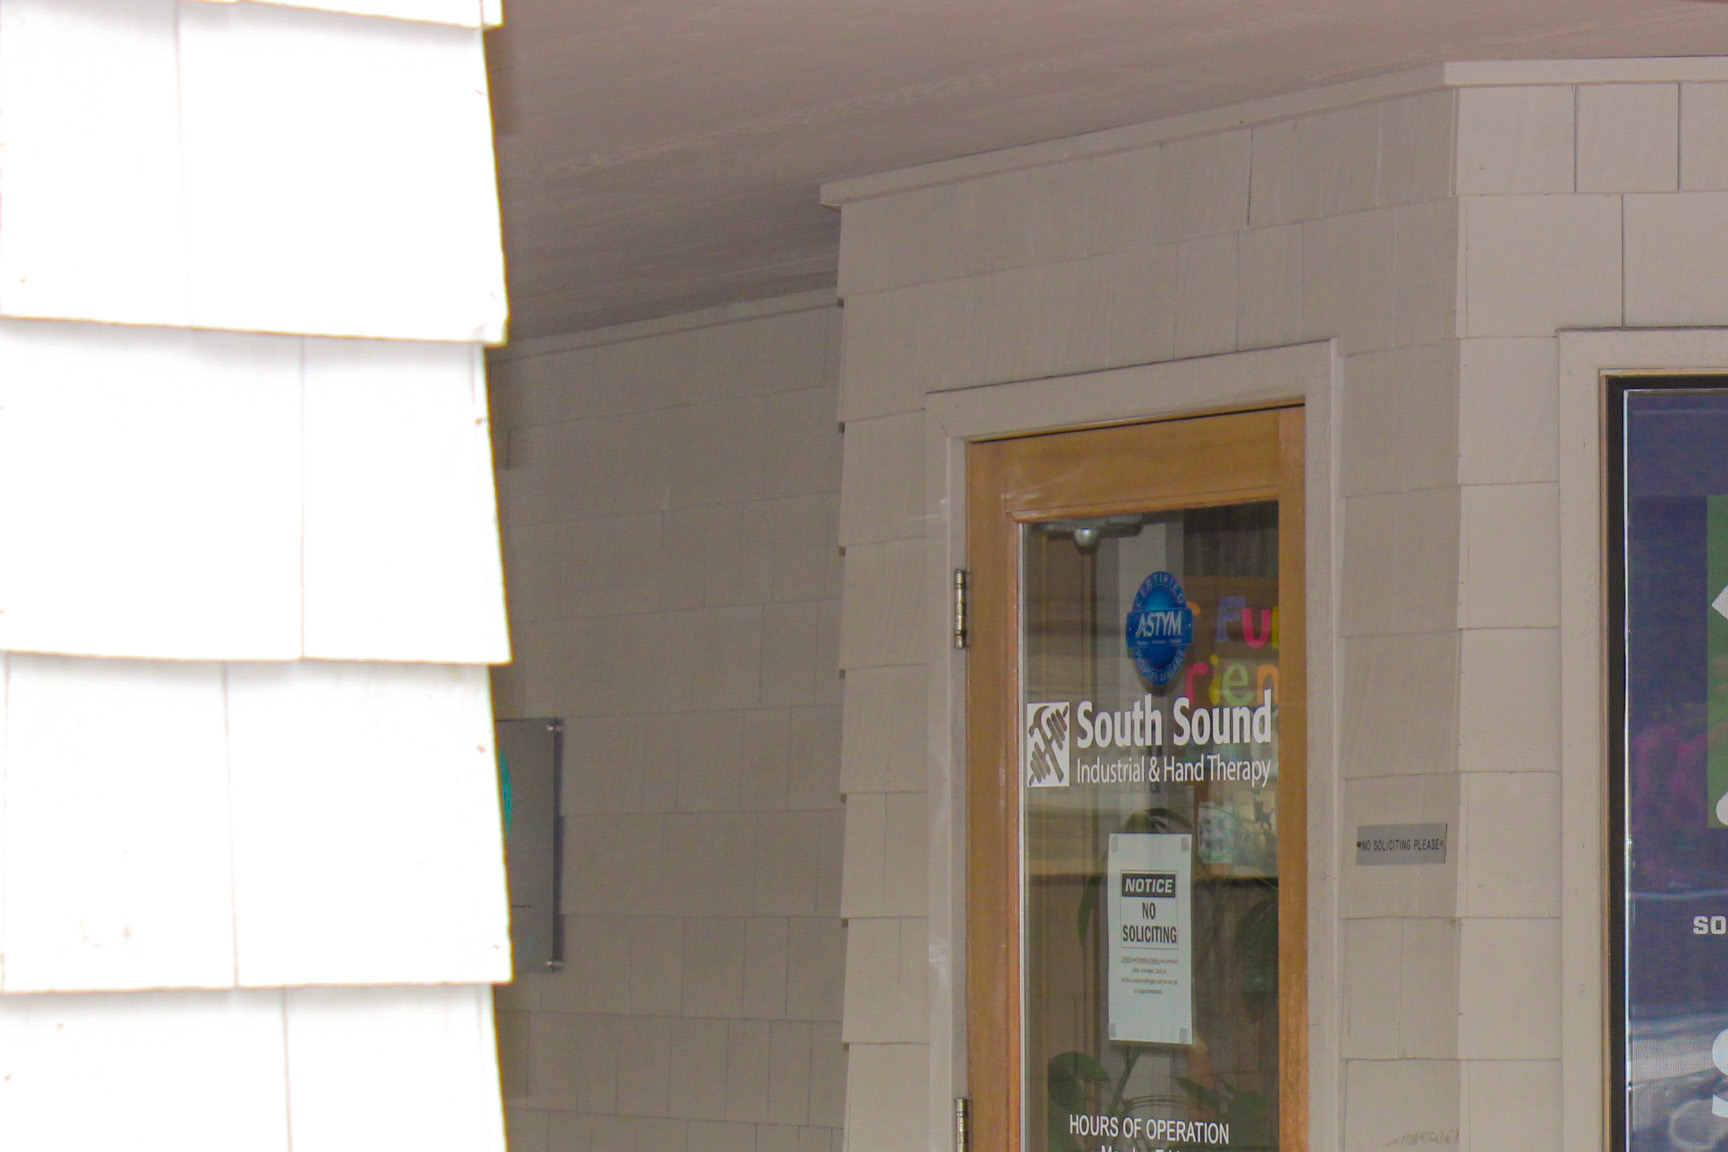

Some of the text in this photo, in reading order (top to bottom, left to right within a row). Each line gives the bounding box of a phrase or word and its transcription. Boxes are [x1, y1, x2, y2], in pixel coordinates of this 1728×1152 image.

[1135, 611, 1182, 638] ASTYM
[1077, 688, 1272, 749] South Sound
[1077, 753, 1271, 788] Industrial & Hand Therapy
[1362, 838, 1440, 852] NO SOLICITING PLEASE
[1125, 878, 1173, 894] NOTICE
[1142, 901, 1156, 920] NO
[1122, 924, 1177, 944] SOLICITING
[1069, 1114, 1230, 1144] HOURS OF OPERATION
